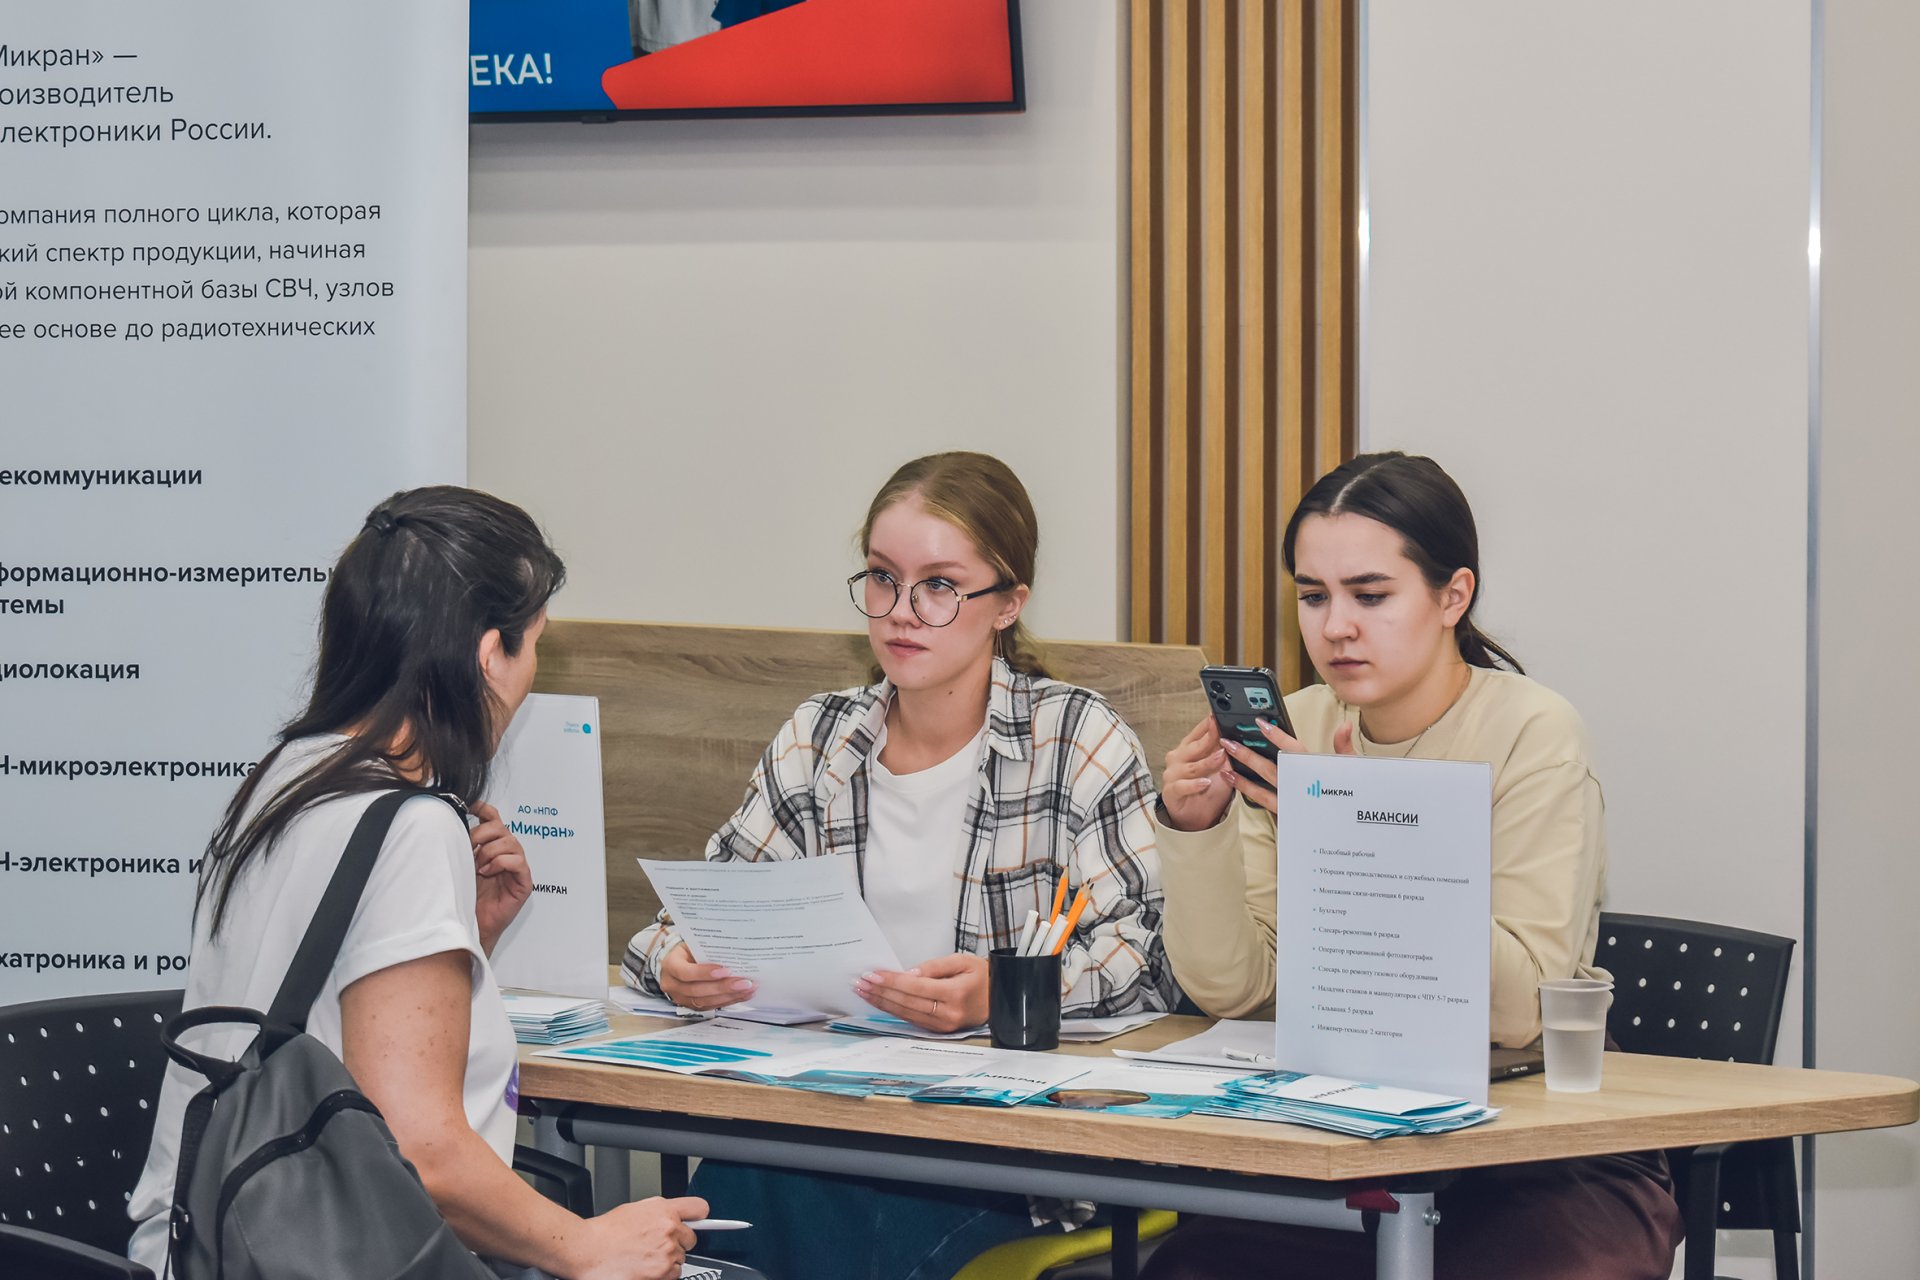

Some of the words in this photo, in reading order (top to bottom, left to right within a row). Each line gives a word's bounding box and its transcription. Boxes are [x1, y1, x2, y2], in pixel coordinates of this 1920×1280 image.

[470, 53, 553, 86] ЕКА!
[0, 85, 174, 108] оизводитель
[0, 124, 161, 149] лектроники
[171, 117, 272, 142] России.
[104, 207, 200, 224] полного
[207, 205, 280, 226] цикла,
[287, 204, 381, 225] которая
[0, 243, 38, 263] кий
[45, 246, 125, 267] спектр
[132, 244, 262, 267] продукции,
[269, 243, 366, 260] начиная
[0, 281, 17, 301] й
[25, 279, 194, 301] компонентной
[201, 278, 258, 300] базы
[265, 277, 319, 301] СВЧ,
[325, 281, 394, 303] узлов
[0, 323, 26, 339] ее
[33, 322, 118, 339] основе
[124, 322, 154, 342] до
[161, 320, 376, 343] радиотехнических
[0, 469, 203, 491] екоммуникации
[0, 560, 334, 587] формационно-измеритель
[0, 598, 64, 615] темы
[0, 663, 140, 683] иолокация
[1321, 788, 1353, 797] МИКРАН
[518, 805, 532, 815] АО
[534, 806, 558, 816] «НПФ
[1356, 810, 1418, 825] ВАКАНСИИ
[1319, 848, 1351, 856] Подсобный
[1352, 850, 1376, 858] рабочий
[1319, 868, 1345, 876] Уборщик
[1346, 870, 1398, 880] производственных
[1404, 874, 1436, 882] служебных
[1436, 876, 1470, 884] помещений
[532, 884, 568, 894] МИКРАН
[1319, 888, 1352, 896] Монтажник
[1318, 908, 1347, 916] Бухгалтер
[1318, 946, 1345, 954] Оператор
[1386, 951, 1433, 961] фотолитографии
[134, 955, 148, 970] и
[156, 954, 191, 976] ро
[1318, 966, 1341, 974] Слесарь
[1399, 972, 1438, 982] оборудования
[1318, 985, 1345, 993] Наладчик
[1374, 990, 1416, 999] манипуляторов
[1422, 992, 1435, 1000] ЧПУ
[1436, 994, 1446, 1002] 5-7
[1317, 1004, 1346, 1013] Гальваник
[1375, 1030, 1403, 1038] категории
